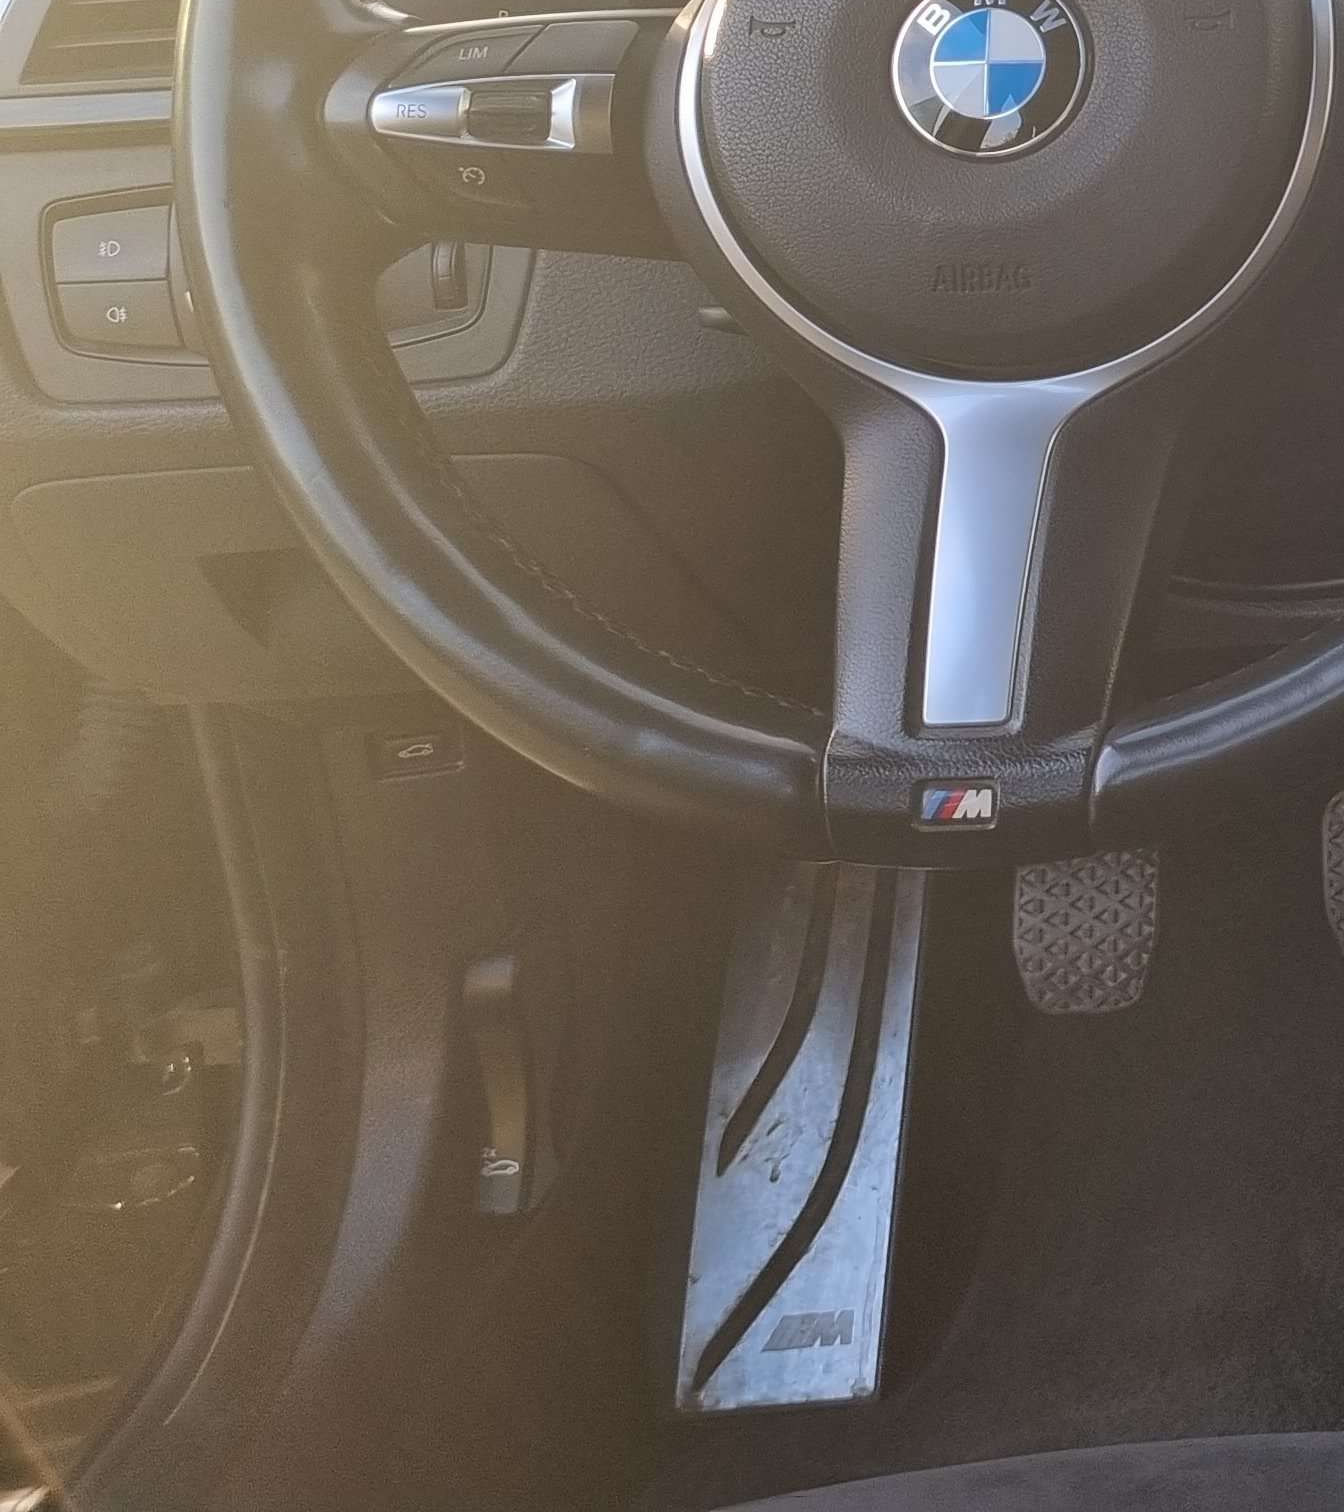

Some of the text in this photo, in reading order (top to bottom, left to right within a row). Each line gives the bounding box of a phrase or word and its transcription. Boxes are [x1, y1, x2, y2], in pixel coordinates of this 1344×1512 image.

[458, 46, 488, 60] LIM
[397, 104, 426, 118] RES
[929, 263, 1032, 293] AIRBAG
[944, 789, 992, 819] M
